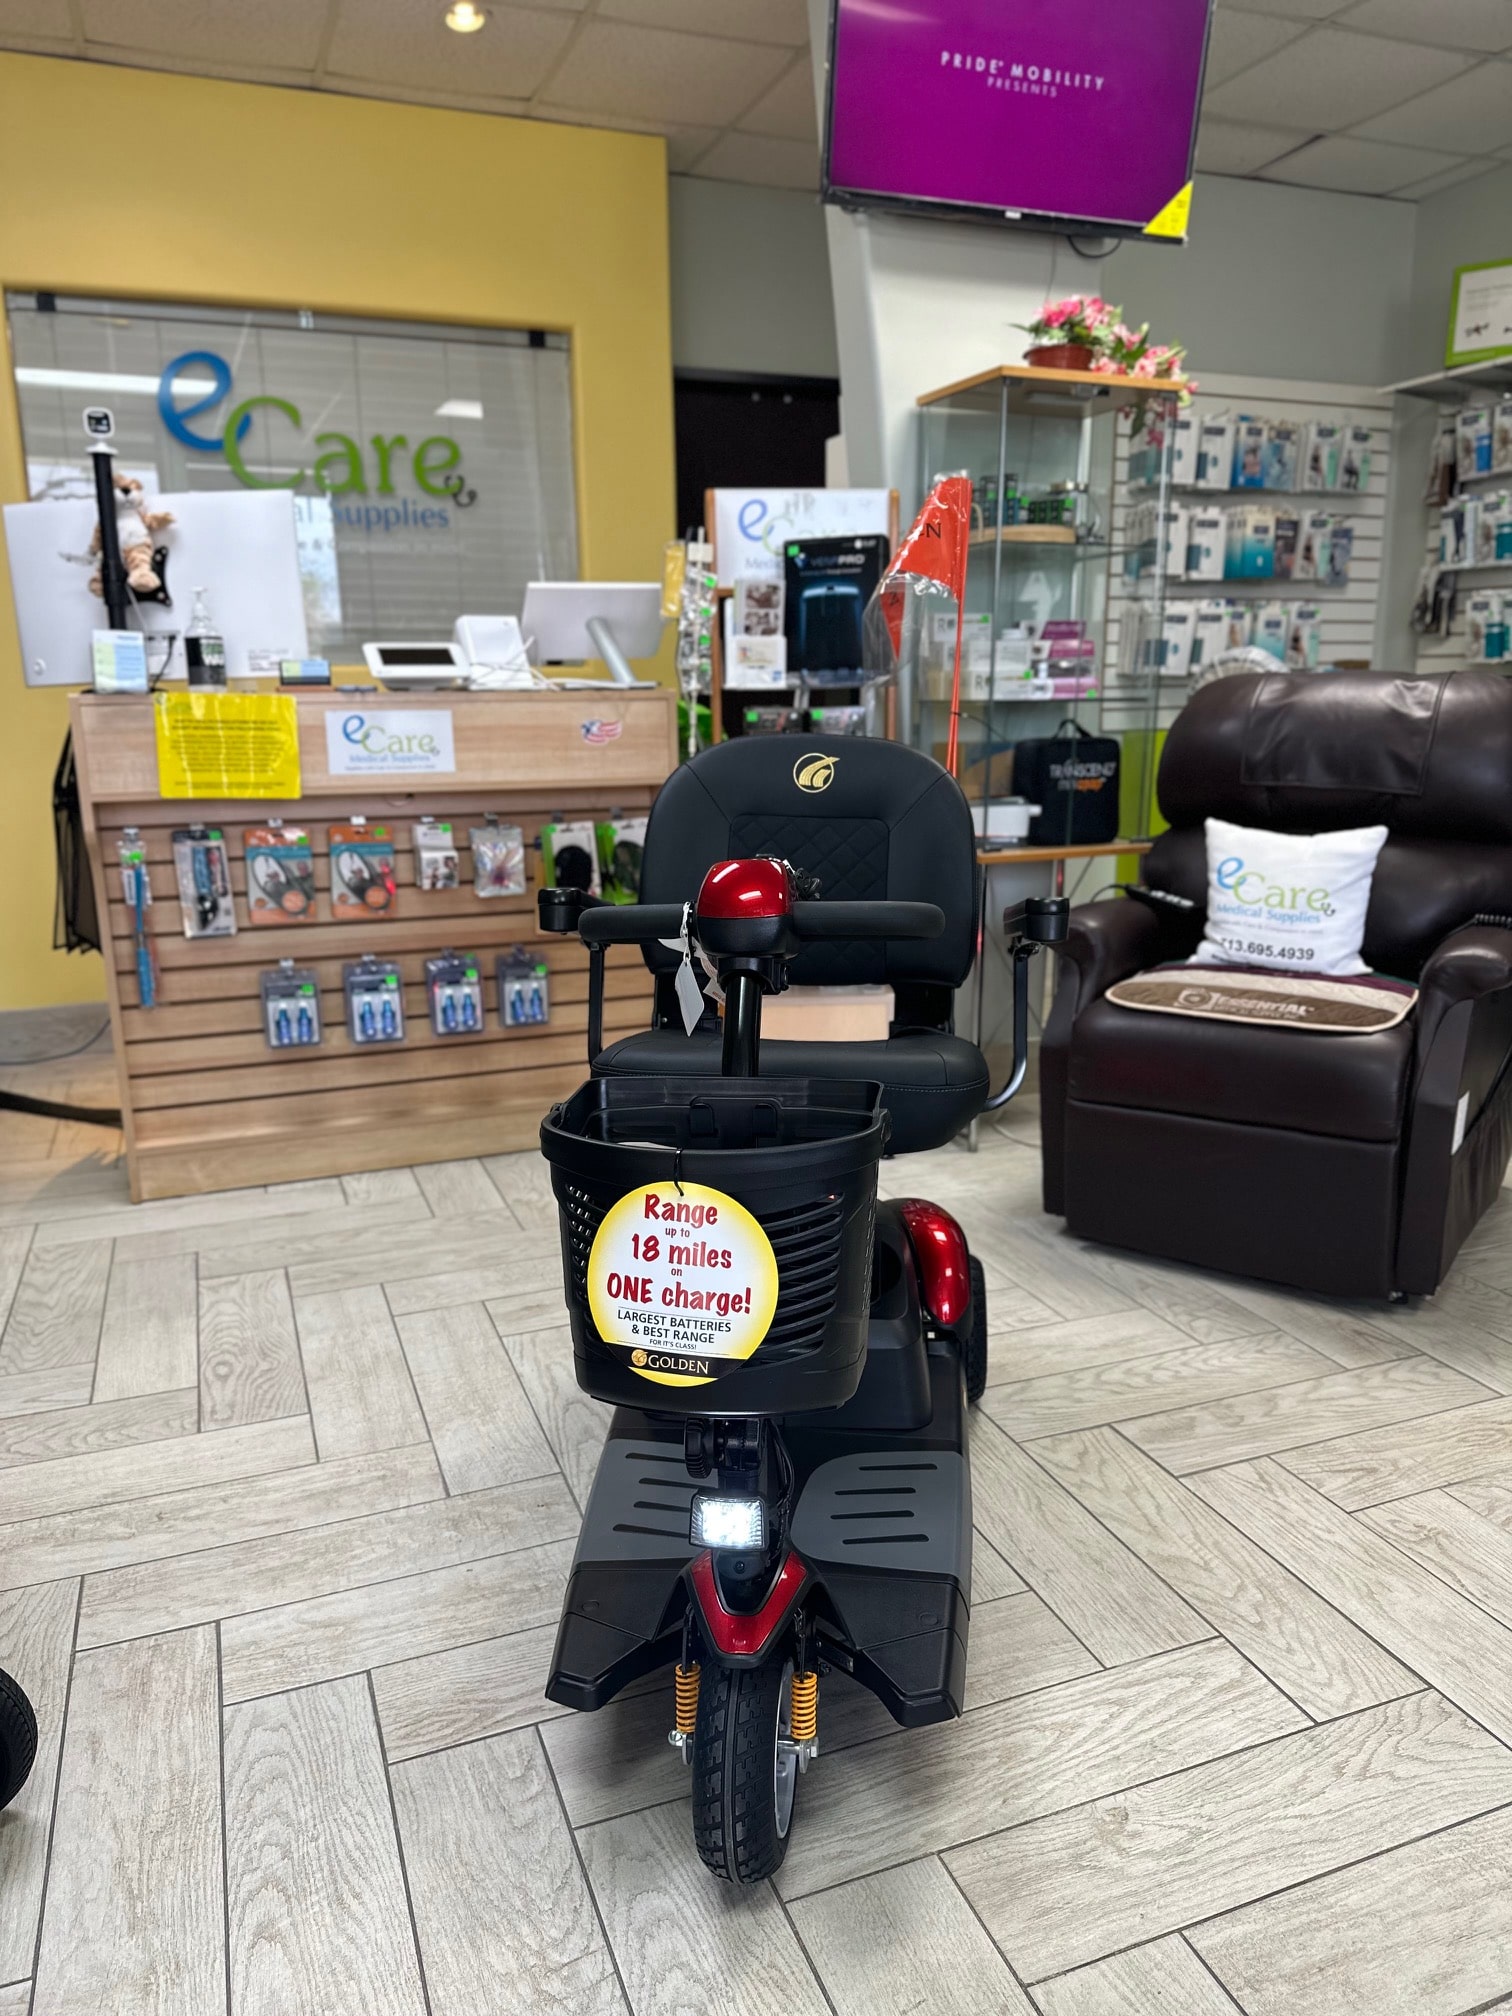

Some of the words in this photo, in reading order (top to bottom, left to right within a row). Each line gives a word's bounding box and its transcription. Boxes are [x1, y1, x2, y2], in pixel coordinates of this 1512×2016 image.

[987, 76, 1058, 98] PRESENTS
[1010, 63, 1104, 91] MOBILITY
[342, 714, 435, 755] eCare
[1216, 856, 1330, 912] eCare
[1216, 903, 1263, 917] Medical
[1267, 909, 1321, 924] Supplies
[644, 1193, 718, 1228] Range
[665, 1227, 677, 1238] up
[680, 1227, 690, 1238] to
[631, 1233, 660, 1262] 18
[668, 1241, 732, 1269] miles
[670, 1266, 683, 1277] on
[606, 1272, 653, 1304] ONE
[661, 1281, 752, 1317] charge!
[617, 1309, 667, 1326] LARGEST
[670, 1317, 732, 1332] BATTERIES
[631, 1324, 640, 1335] &
[643, 1325, 670, 1339] BEST
[673, 1330, 715, 1343] RANGE
[649, 1338, 662, 1346] FOR
[675, 1342, 697, 1350] CLASS!
[648, 1354, 709, 1374] GOLDEN
